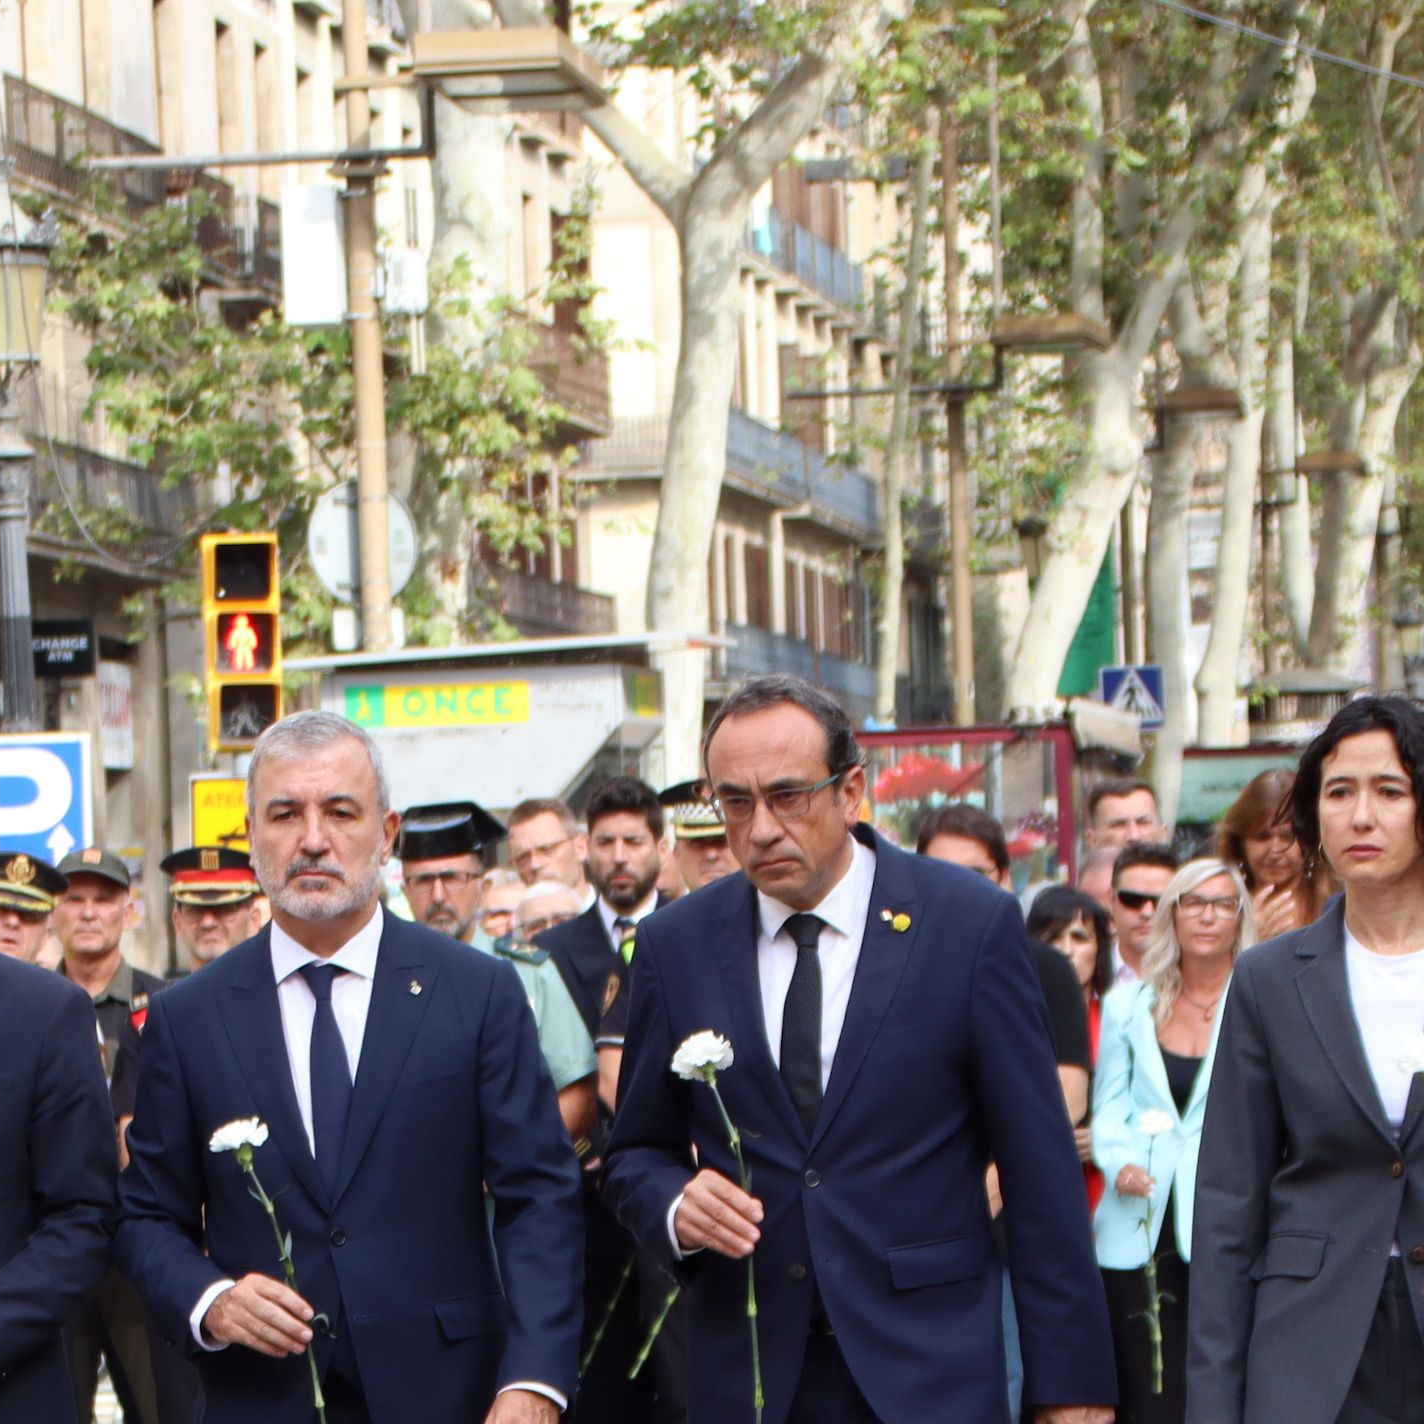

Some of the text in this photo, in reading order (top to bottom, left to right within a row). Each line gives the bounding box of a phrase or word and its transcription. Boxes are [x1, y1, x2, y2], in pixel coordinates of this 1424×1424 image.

[31, 637, 88, 651] CHANGE
[47, 650, 74, 663] ATM
[401, 685, 514, 718] ONCE
